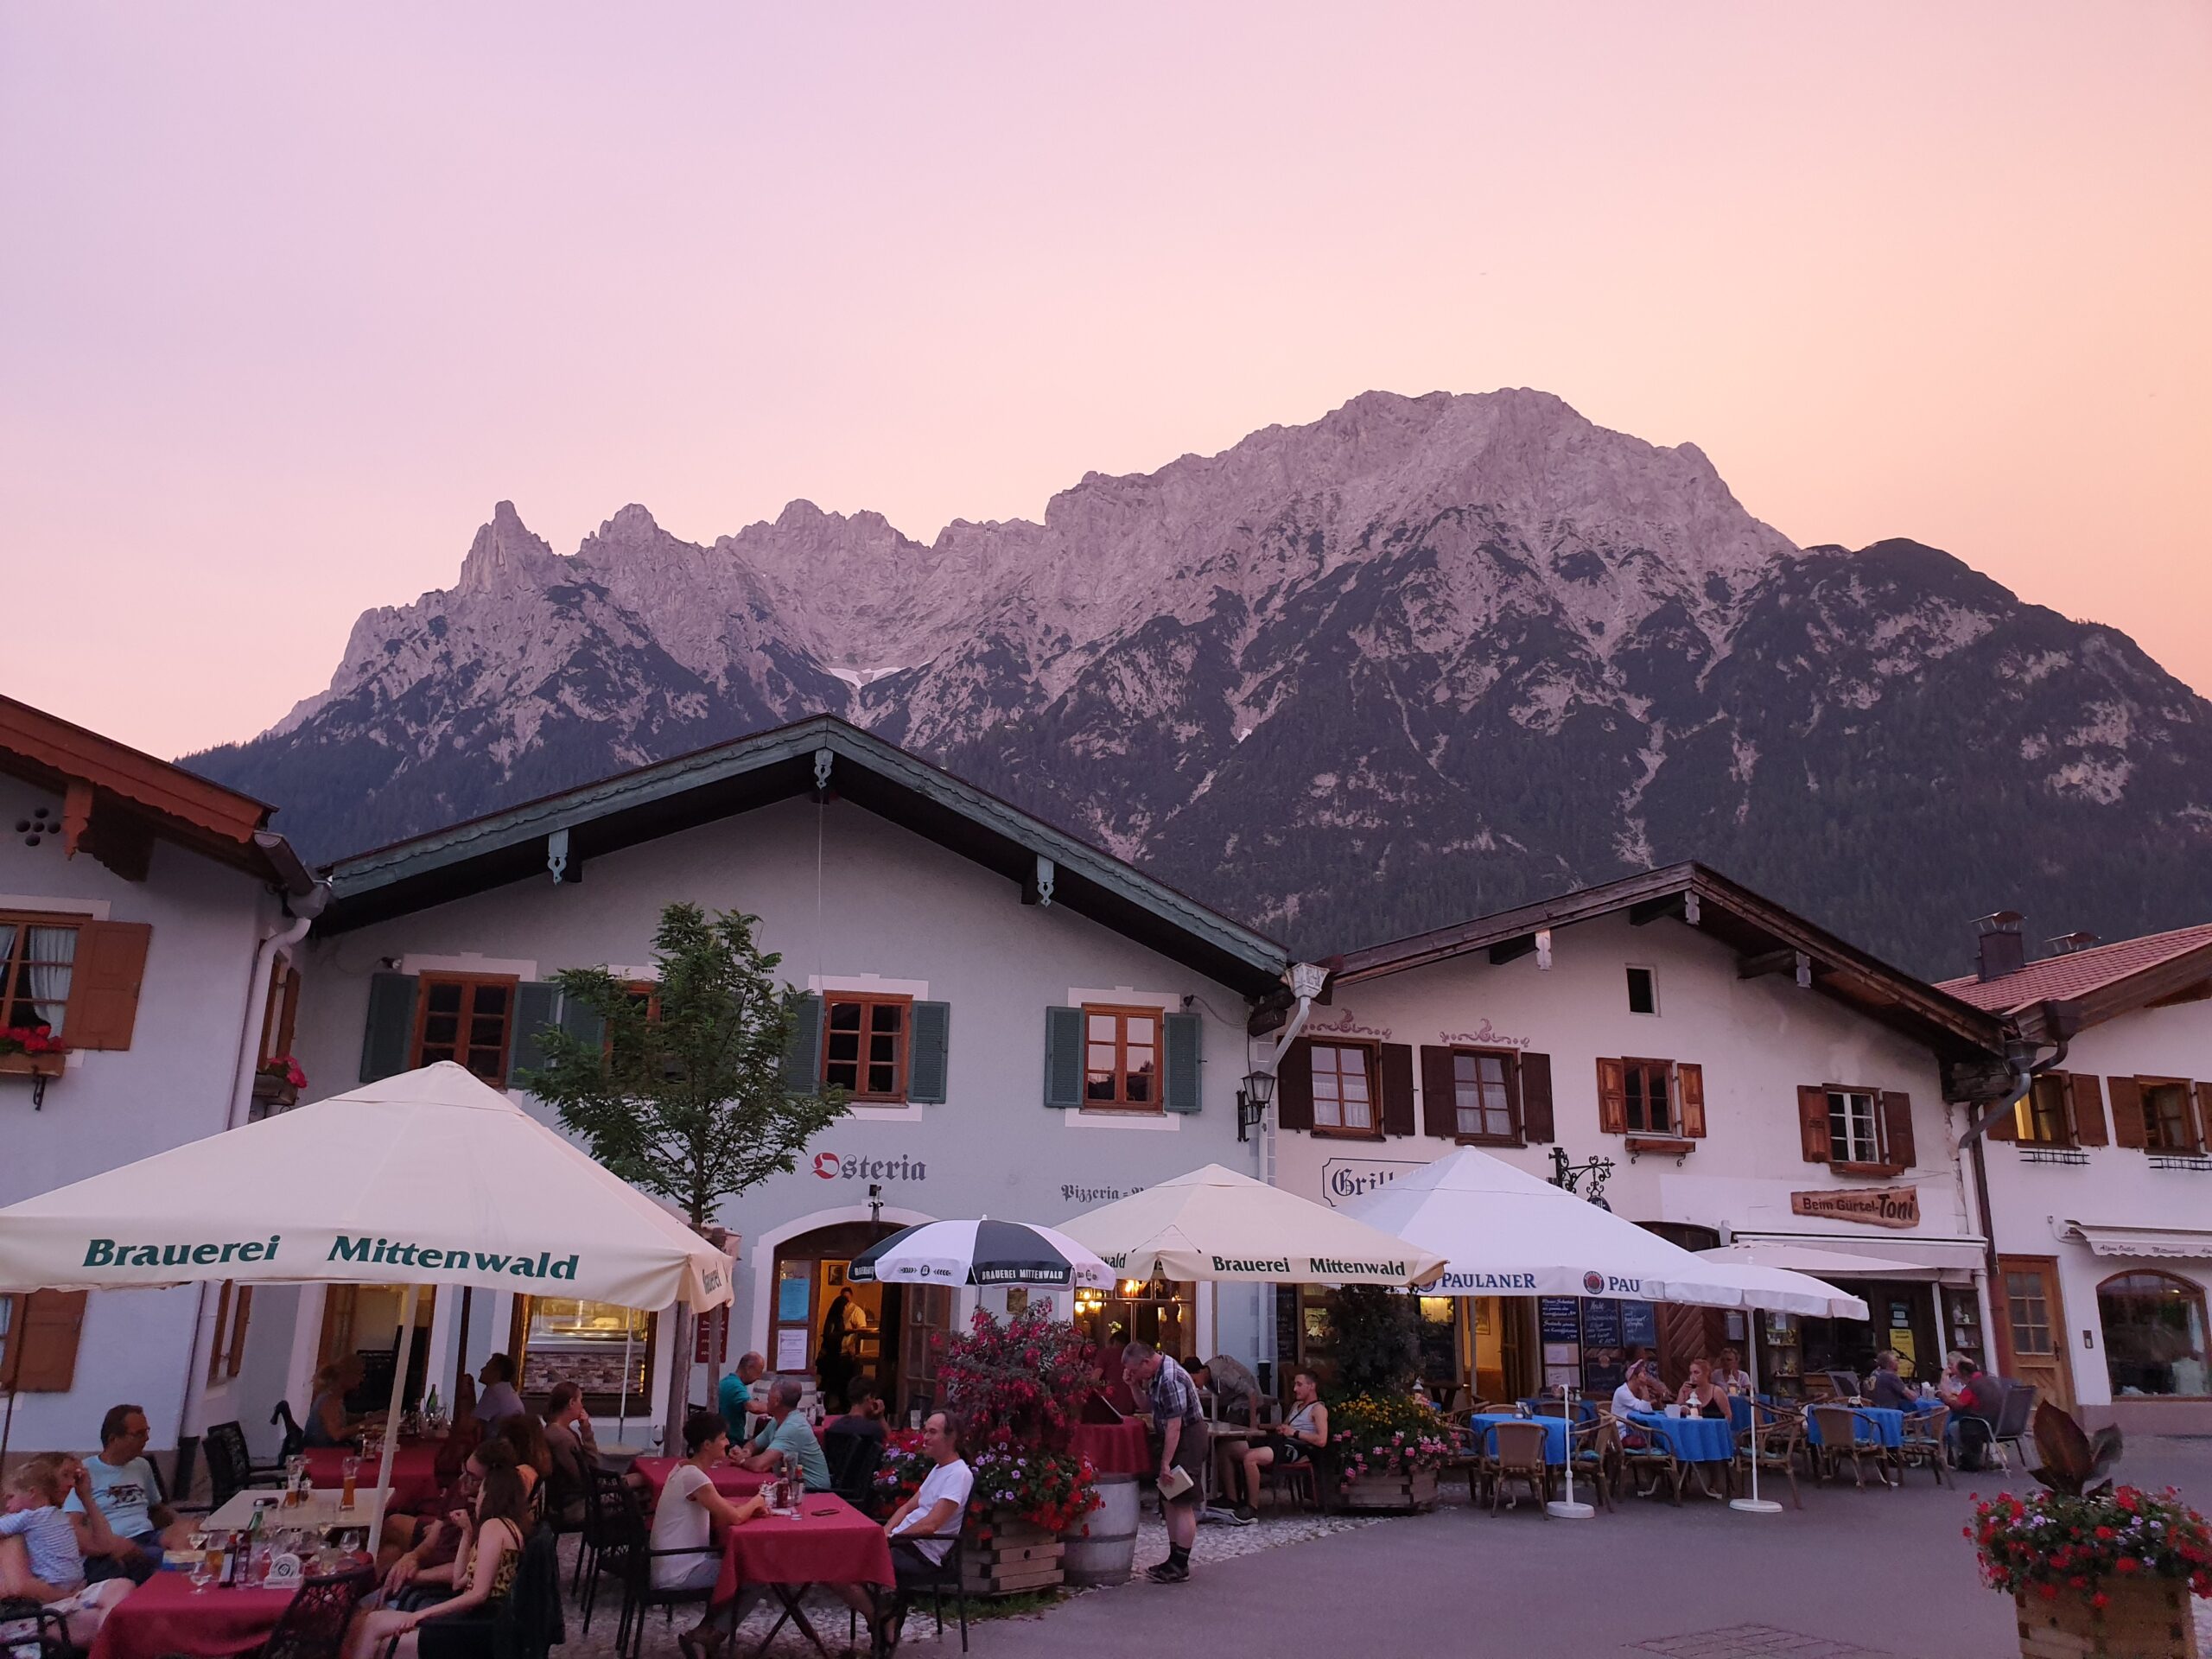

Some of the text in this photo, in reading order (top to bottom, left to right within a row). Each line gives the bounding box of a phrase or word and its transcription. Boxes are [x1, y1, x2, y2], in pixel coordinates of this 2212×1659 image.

[810, 1152, 926, 1181] Osteria
[1061, 1185, 1119, 1203] Pizzeria
[1802, 1198, 1834, 1211] Beim
[82, 1235, 580, 1280] Brauerei Mittenwald
[1211, 1255, 1406, 1276] Brauerei Mittenwald
[982, 1269, 1064, 1281] BRAUEREI MITTENWALD
[1440, 1273, 1537, 1289] PAULANER
[1608, 1275, 1641, 1293] PAU
